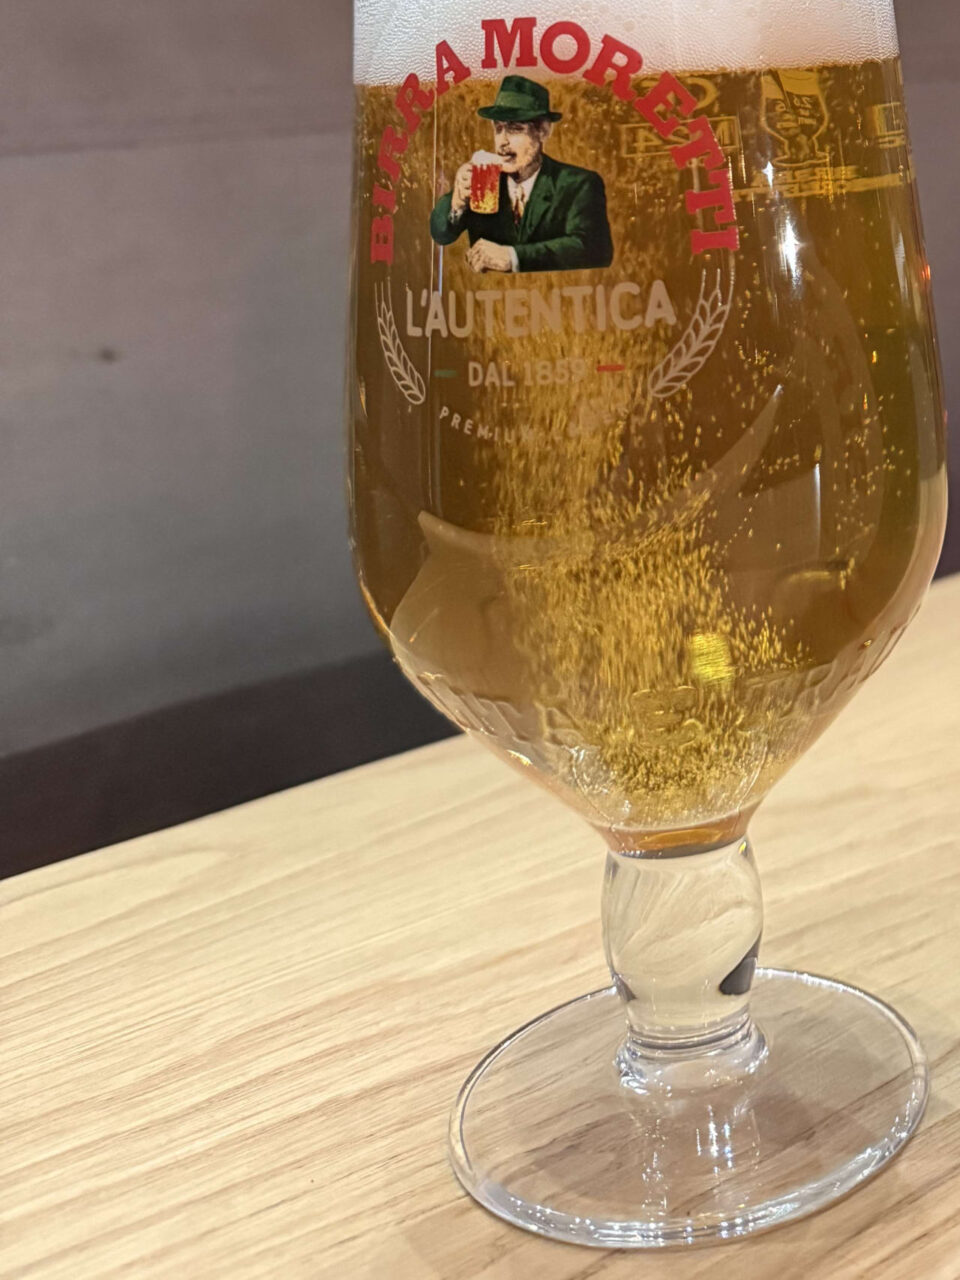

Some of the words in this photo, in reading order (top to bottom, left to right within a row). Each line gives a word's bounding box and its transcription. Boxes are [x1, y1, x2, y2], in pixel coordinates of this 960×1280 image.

[370, 39, 472, 266] BIRRA
[480, 16, 740, 255] MORETTI
[404, 279, 678, 339] L'AUTENTICA
[467, 360, 516, 388] DAL
[523, 357, 586, 387] 1859
